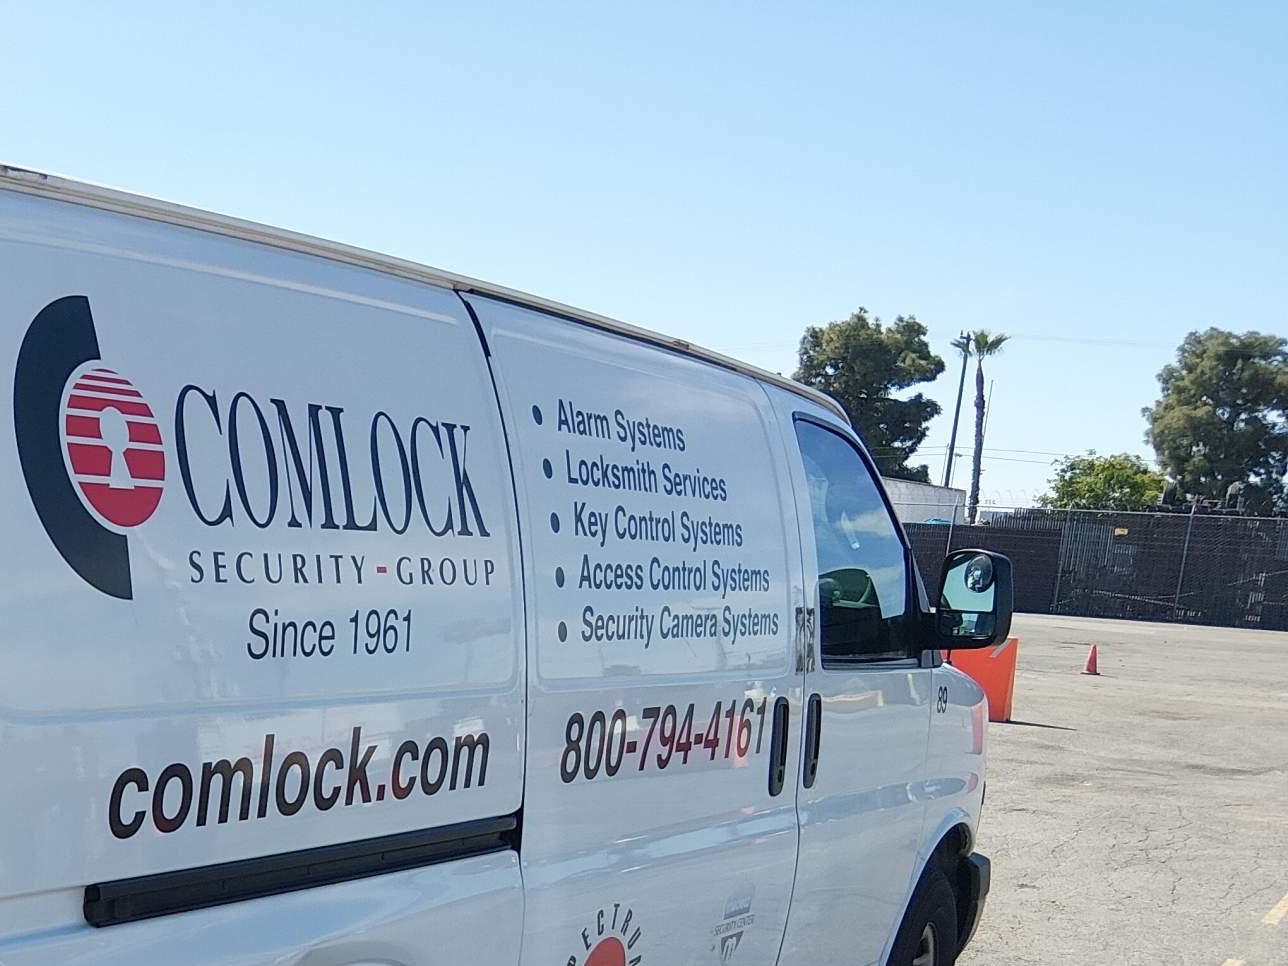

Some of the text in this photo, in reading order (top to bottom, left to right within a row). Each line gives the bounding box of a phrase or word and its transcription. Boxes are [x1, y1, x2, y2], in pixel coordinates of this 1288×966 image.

[557, 399, 686, 452] Alarm Systems
[174, 384, 491, 538] COMLOCK
[565, 449, 727, 501] Locksmith Services
[573, 501, 743, 552] Key Control Systems
[578, 554, 770, 599] Access Control Systems
[247, 608, 413, 660] Since 1961
[581, 605, 779, 649] Security Camera Systems
[937, 686, 948, 714] 89
[560, 696, 768, 784] 800-794-4161
[108, 726, 490, 840] comlock.com
